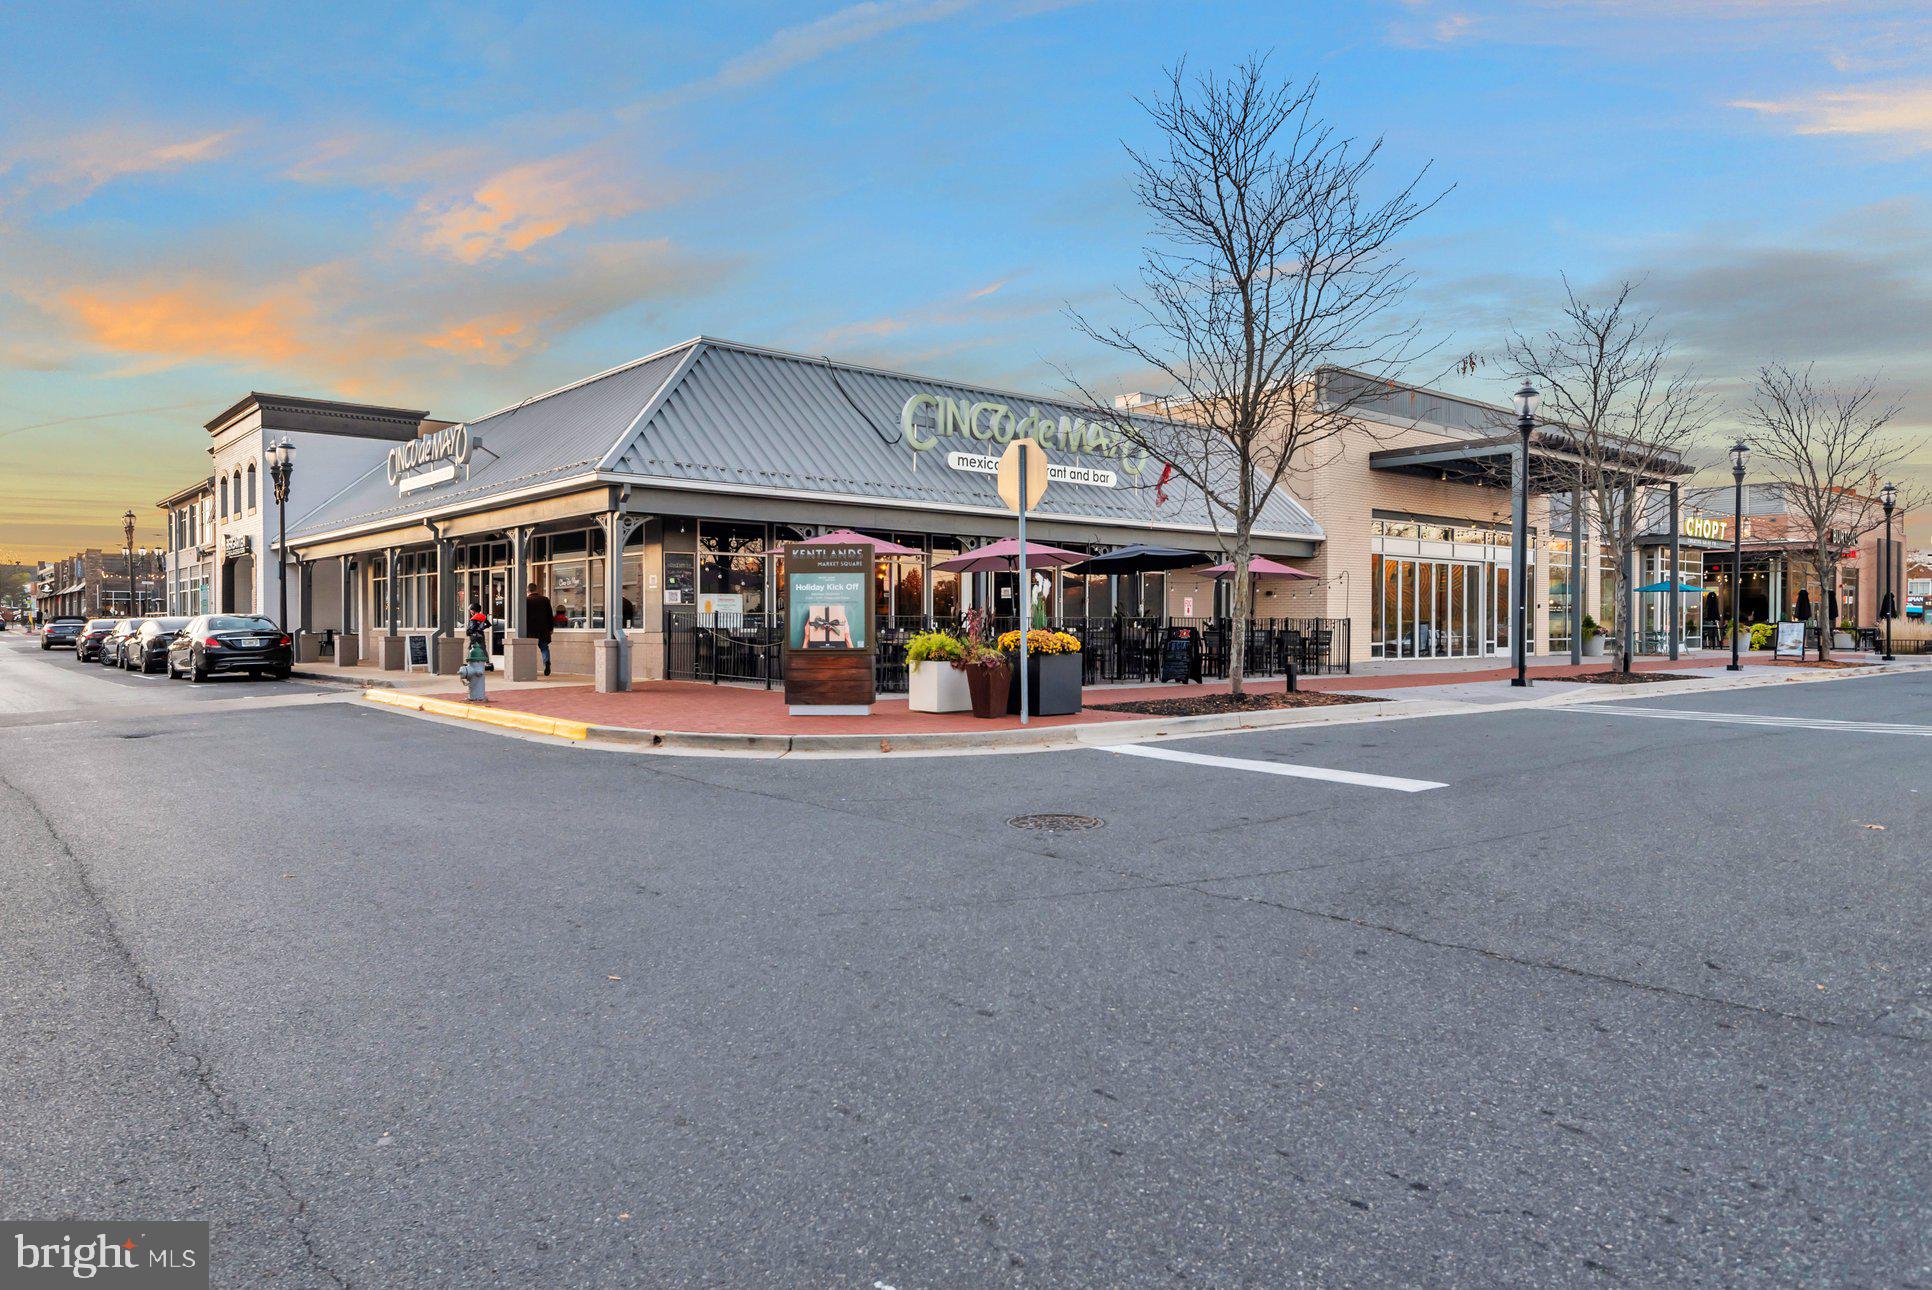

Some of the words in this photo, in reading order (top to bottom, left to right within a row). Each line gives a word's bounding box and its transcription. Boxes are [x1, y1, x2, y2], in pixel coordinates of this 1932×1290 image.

[901, 393, 1016, 451] CINCO
[387, 439, 418, 486] CINCO
[1069, 470, 1090, 482] and
[1092, 470, 1110, 483] bar
[1684, 516, 1727, 540] CHOPT
[792, 549, 863, 559] KENTLANDS
[795, 583, 825, 592] Holiday
[826, 583, 844, 591] Kick
[845, 583, 860, 591] Off
